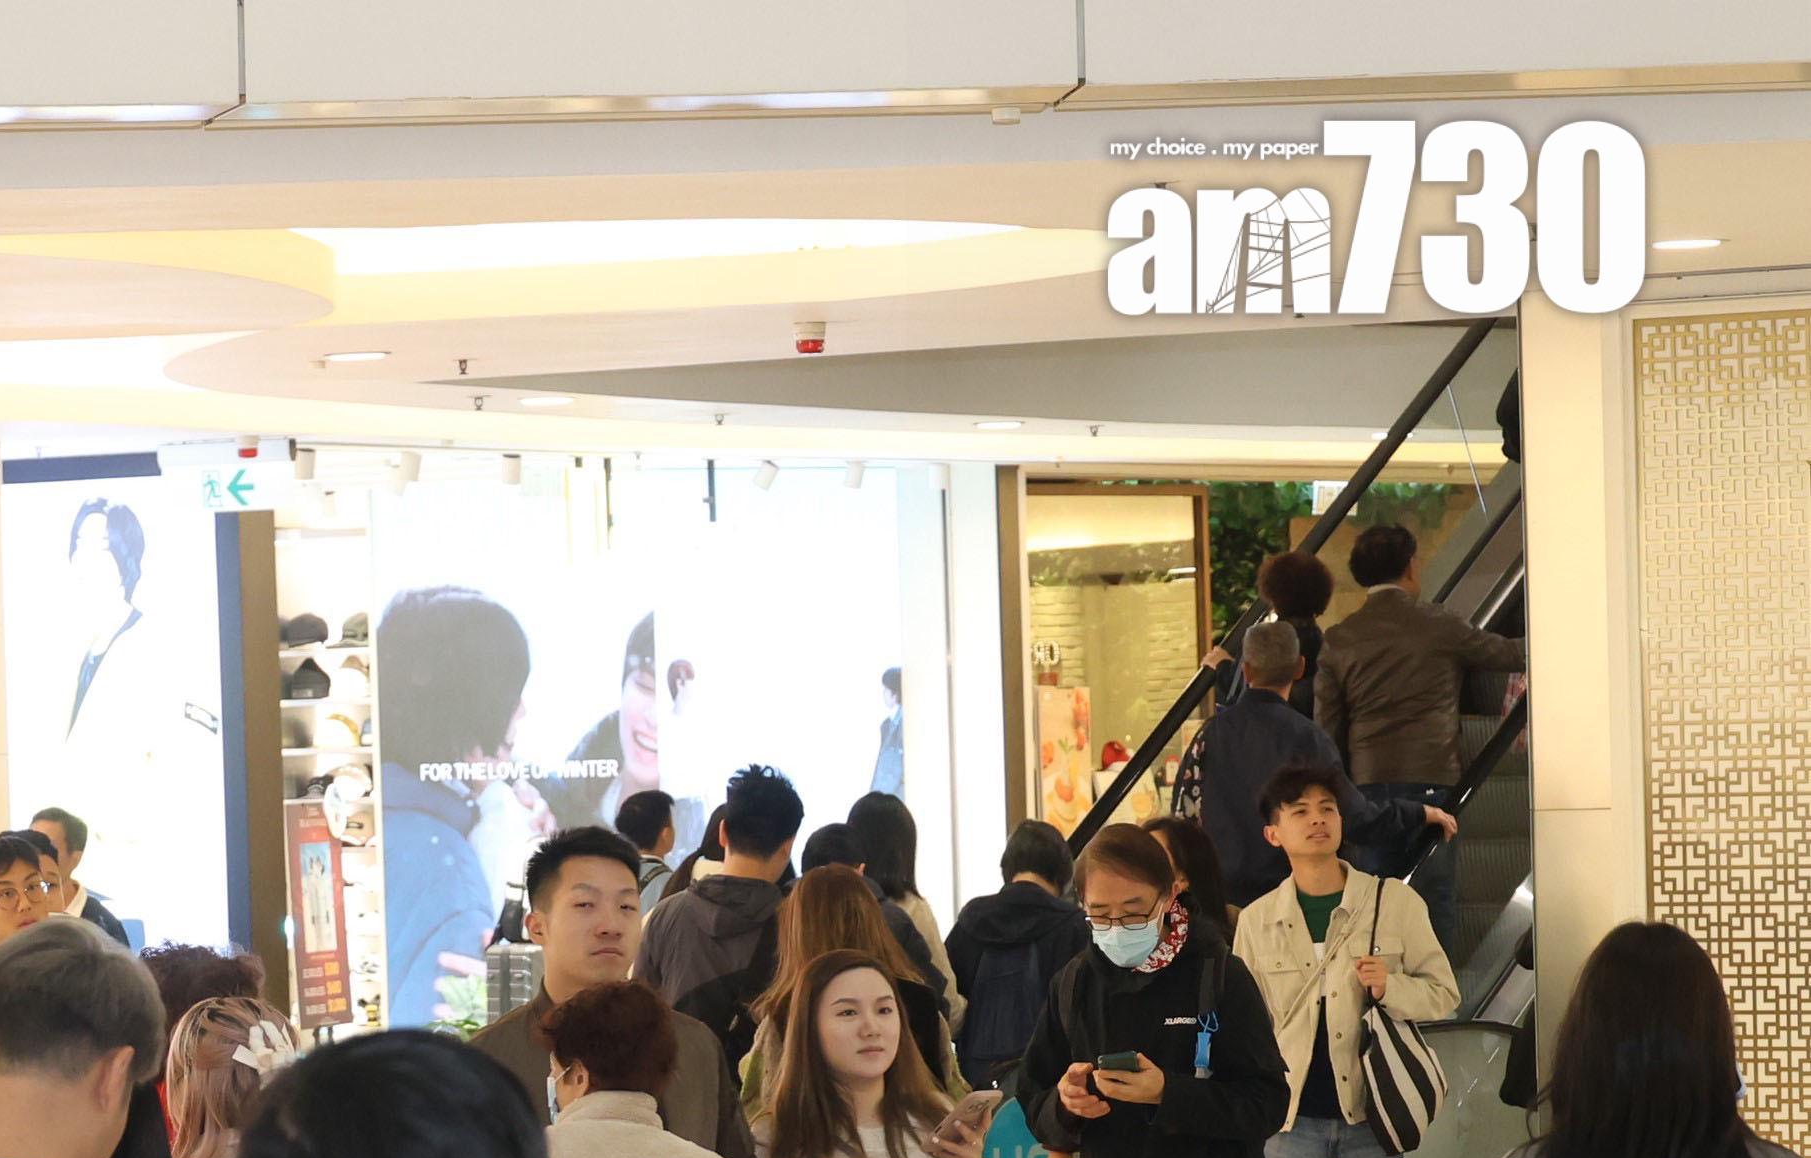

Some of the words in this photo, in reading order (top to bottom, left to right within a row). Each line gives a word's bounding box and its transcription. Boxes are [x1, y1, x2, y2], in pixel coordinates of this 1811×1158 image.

[419, 763, 453, 782] FOR
[454, 761, 486, 781] THE
[487, 761, 531, 780] LOVE
[555, 759, 619, 779] WINTER
